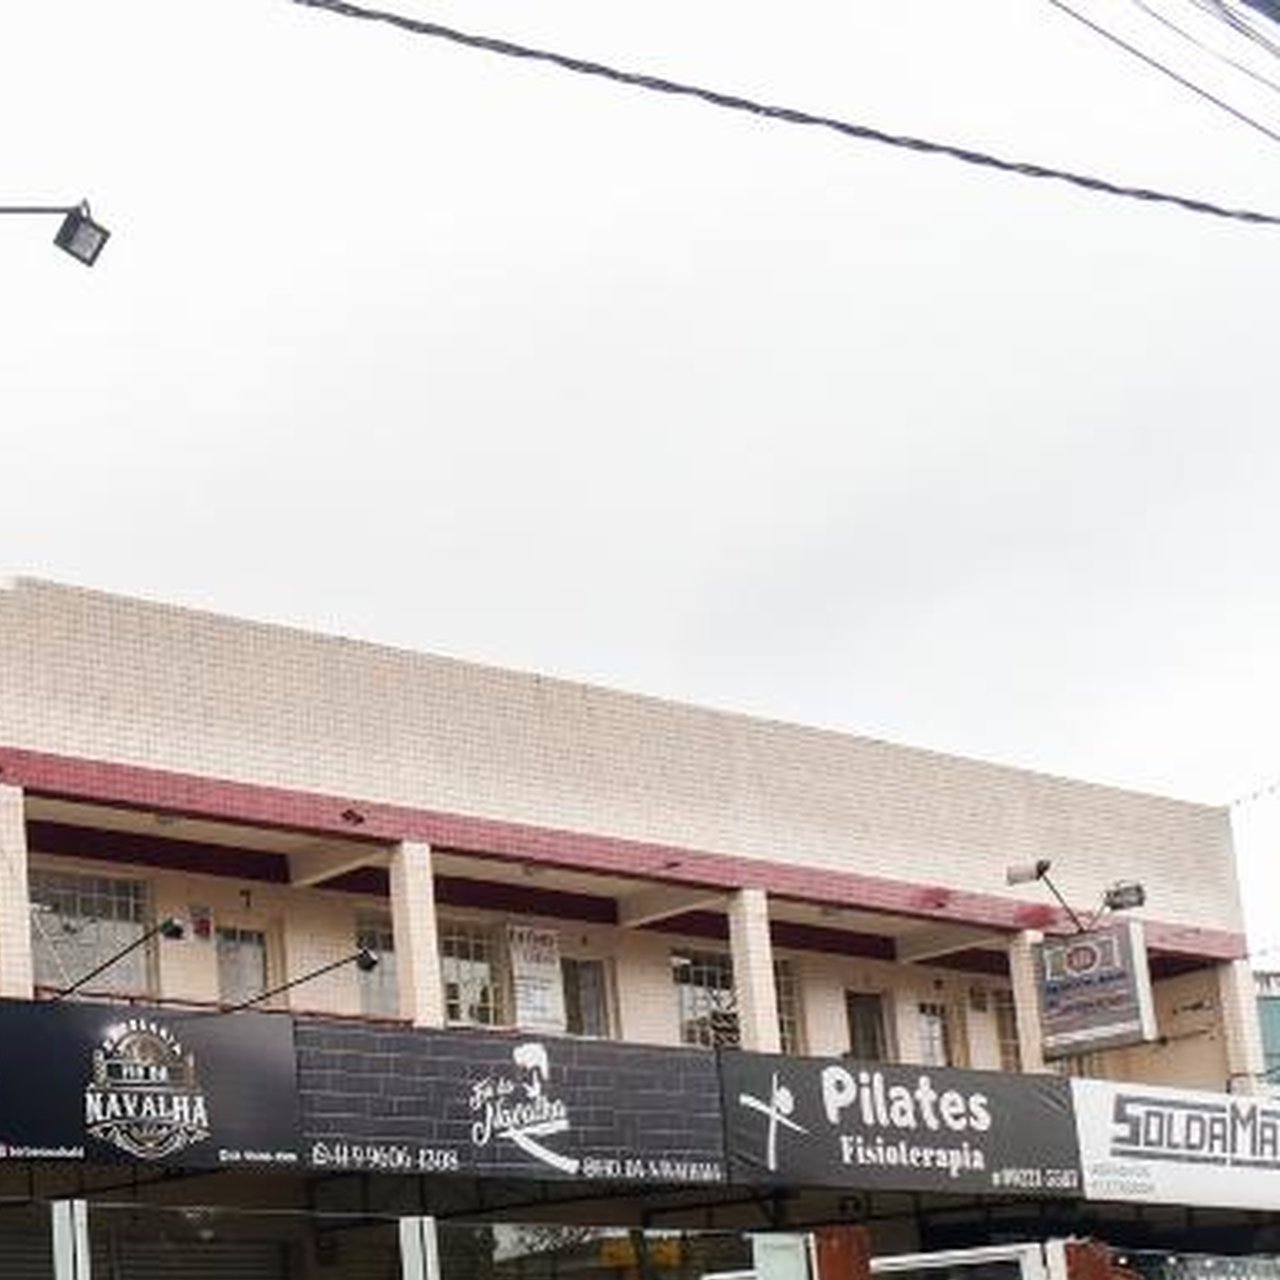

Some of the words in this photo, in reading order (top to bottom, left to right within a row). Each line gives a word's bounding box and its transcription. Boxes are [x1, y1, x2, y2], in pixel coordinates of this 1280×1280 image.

[85, 1092, 209, 1127] NAVALHA
[821, 1066, 991, 1132] Pilates
[839, 1136, 985, 1177] Fisioterapia
